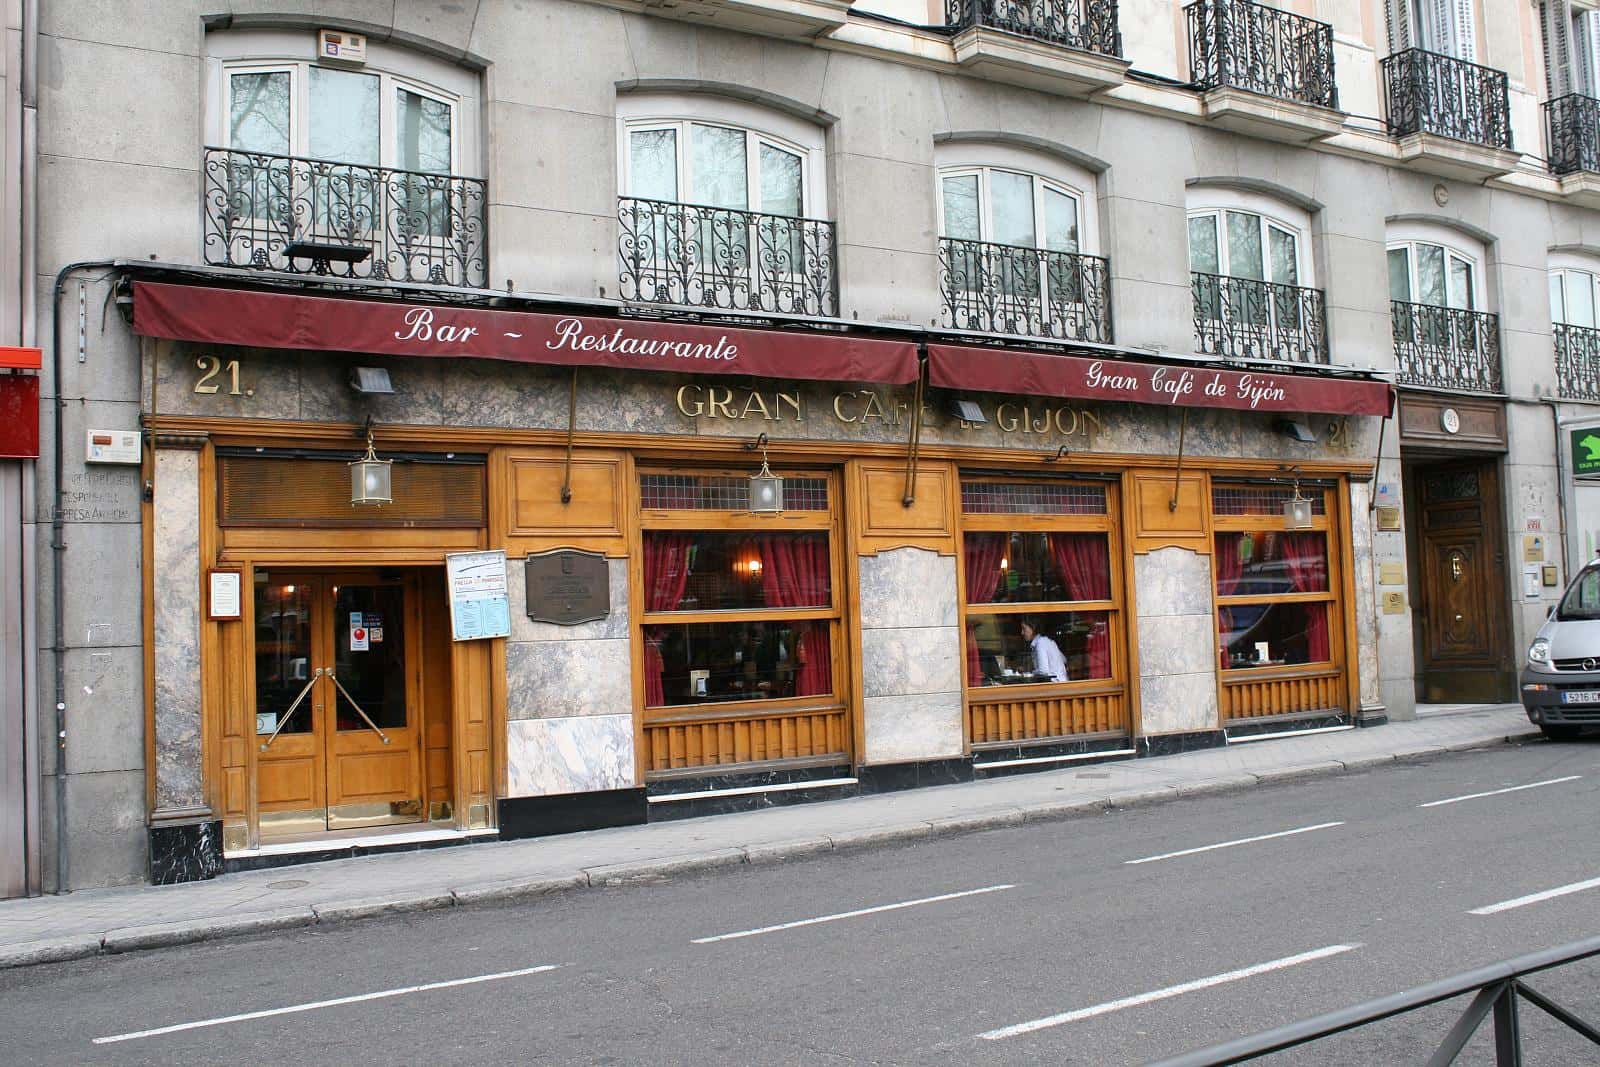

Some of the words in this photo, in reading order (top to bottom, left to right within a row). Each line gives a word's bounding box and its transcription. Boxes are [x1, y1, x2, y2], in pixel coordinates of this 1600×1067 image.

[394, 308, 479, 342] Bar
[546, 319, 738, 360] Restaurante
[194, 355, 254, 396] 21.
[1086, 361, 1139, 390] Gran
[1150, 368, 1193, 404] Café
[1204, 374, 1226, 396] de
[1236, 374, 1286, 408] Gijón
[676, 385, 803, 422] GRAN
